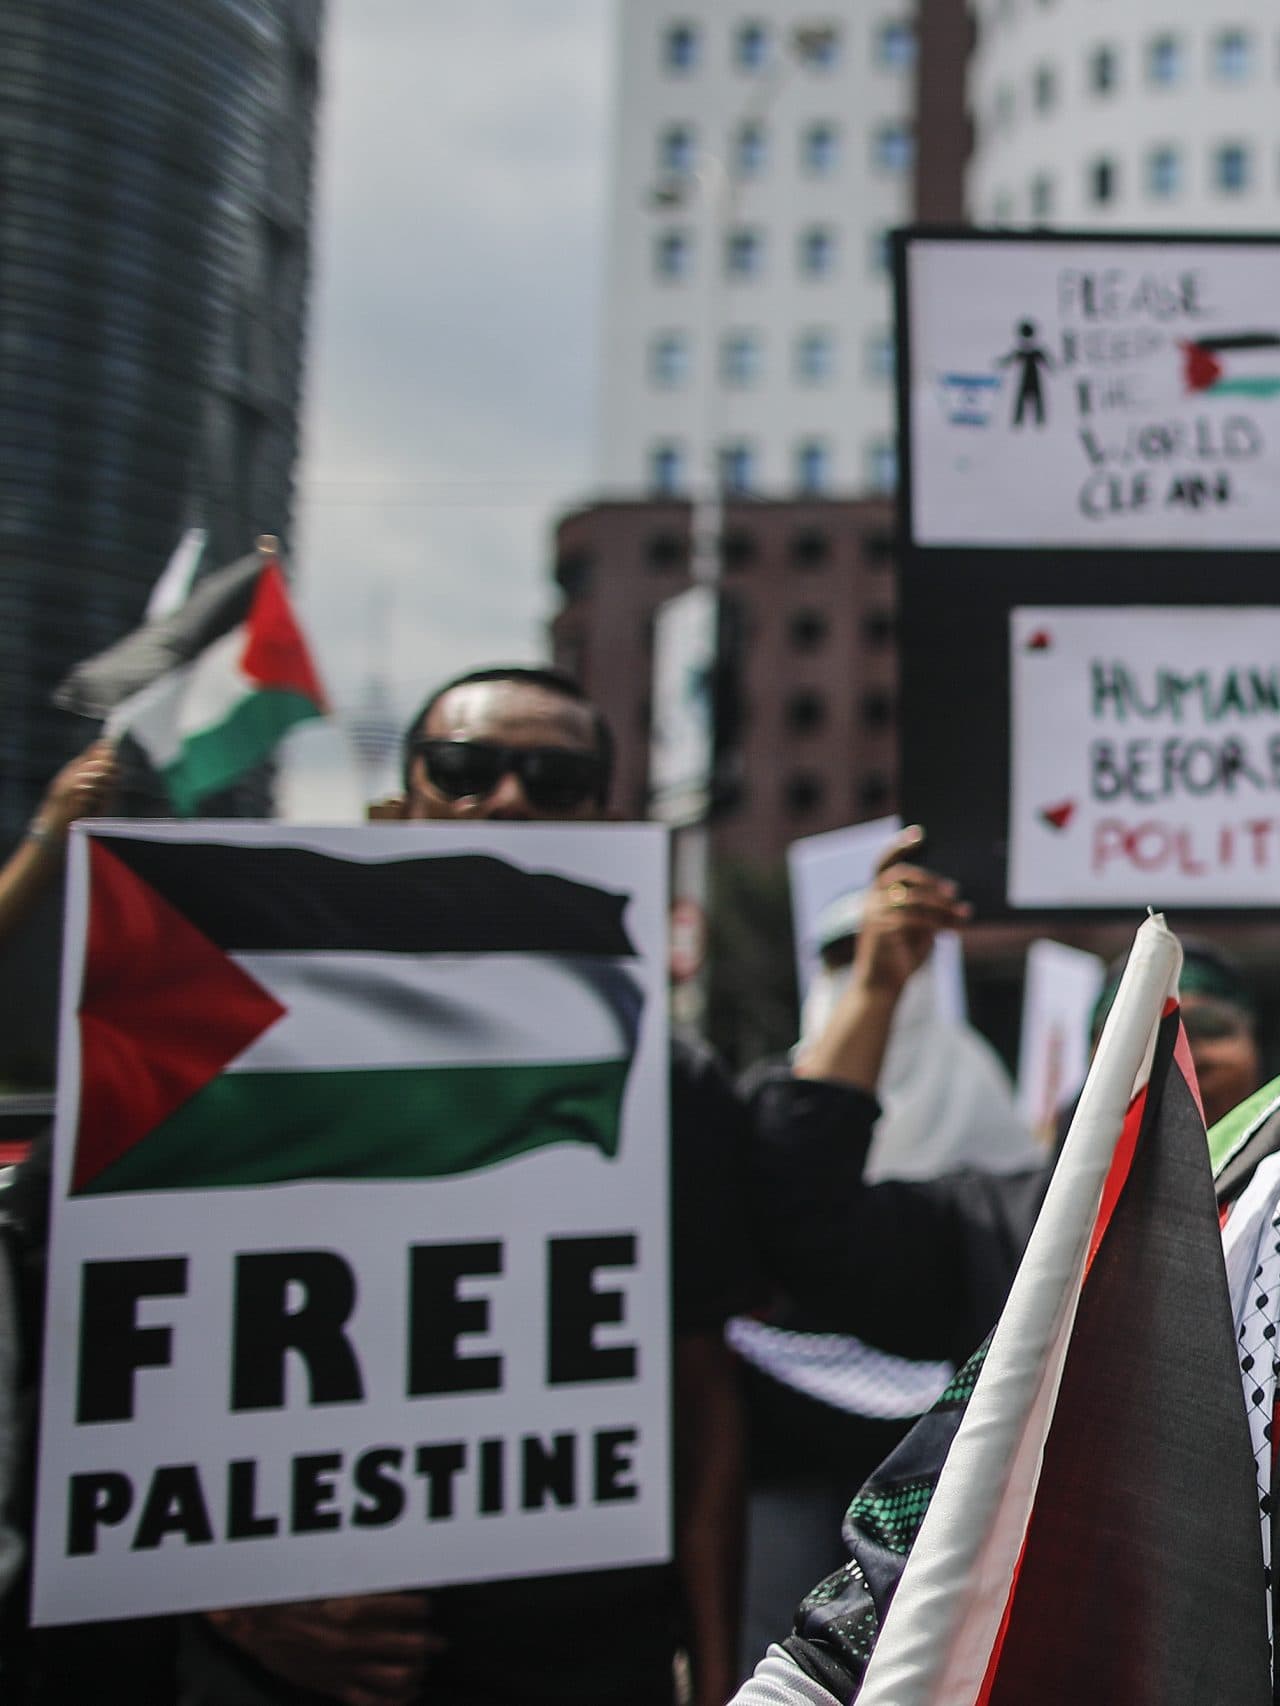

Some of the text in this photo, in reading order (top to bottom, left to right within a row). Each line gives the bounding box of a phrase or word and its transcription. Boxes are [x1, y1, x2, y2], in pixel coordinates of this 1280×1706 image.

[1057, 267, 1216, 322] PLEASE
[1077, 468, 1234, 523] CLEAN
[76, 1234, 637, 1424] FREE
[67, 1427, 638, 1556] PALESTINE
